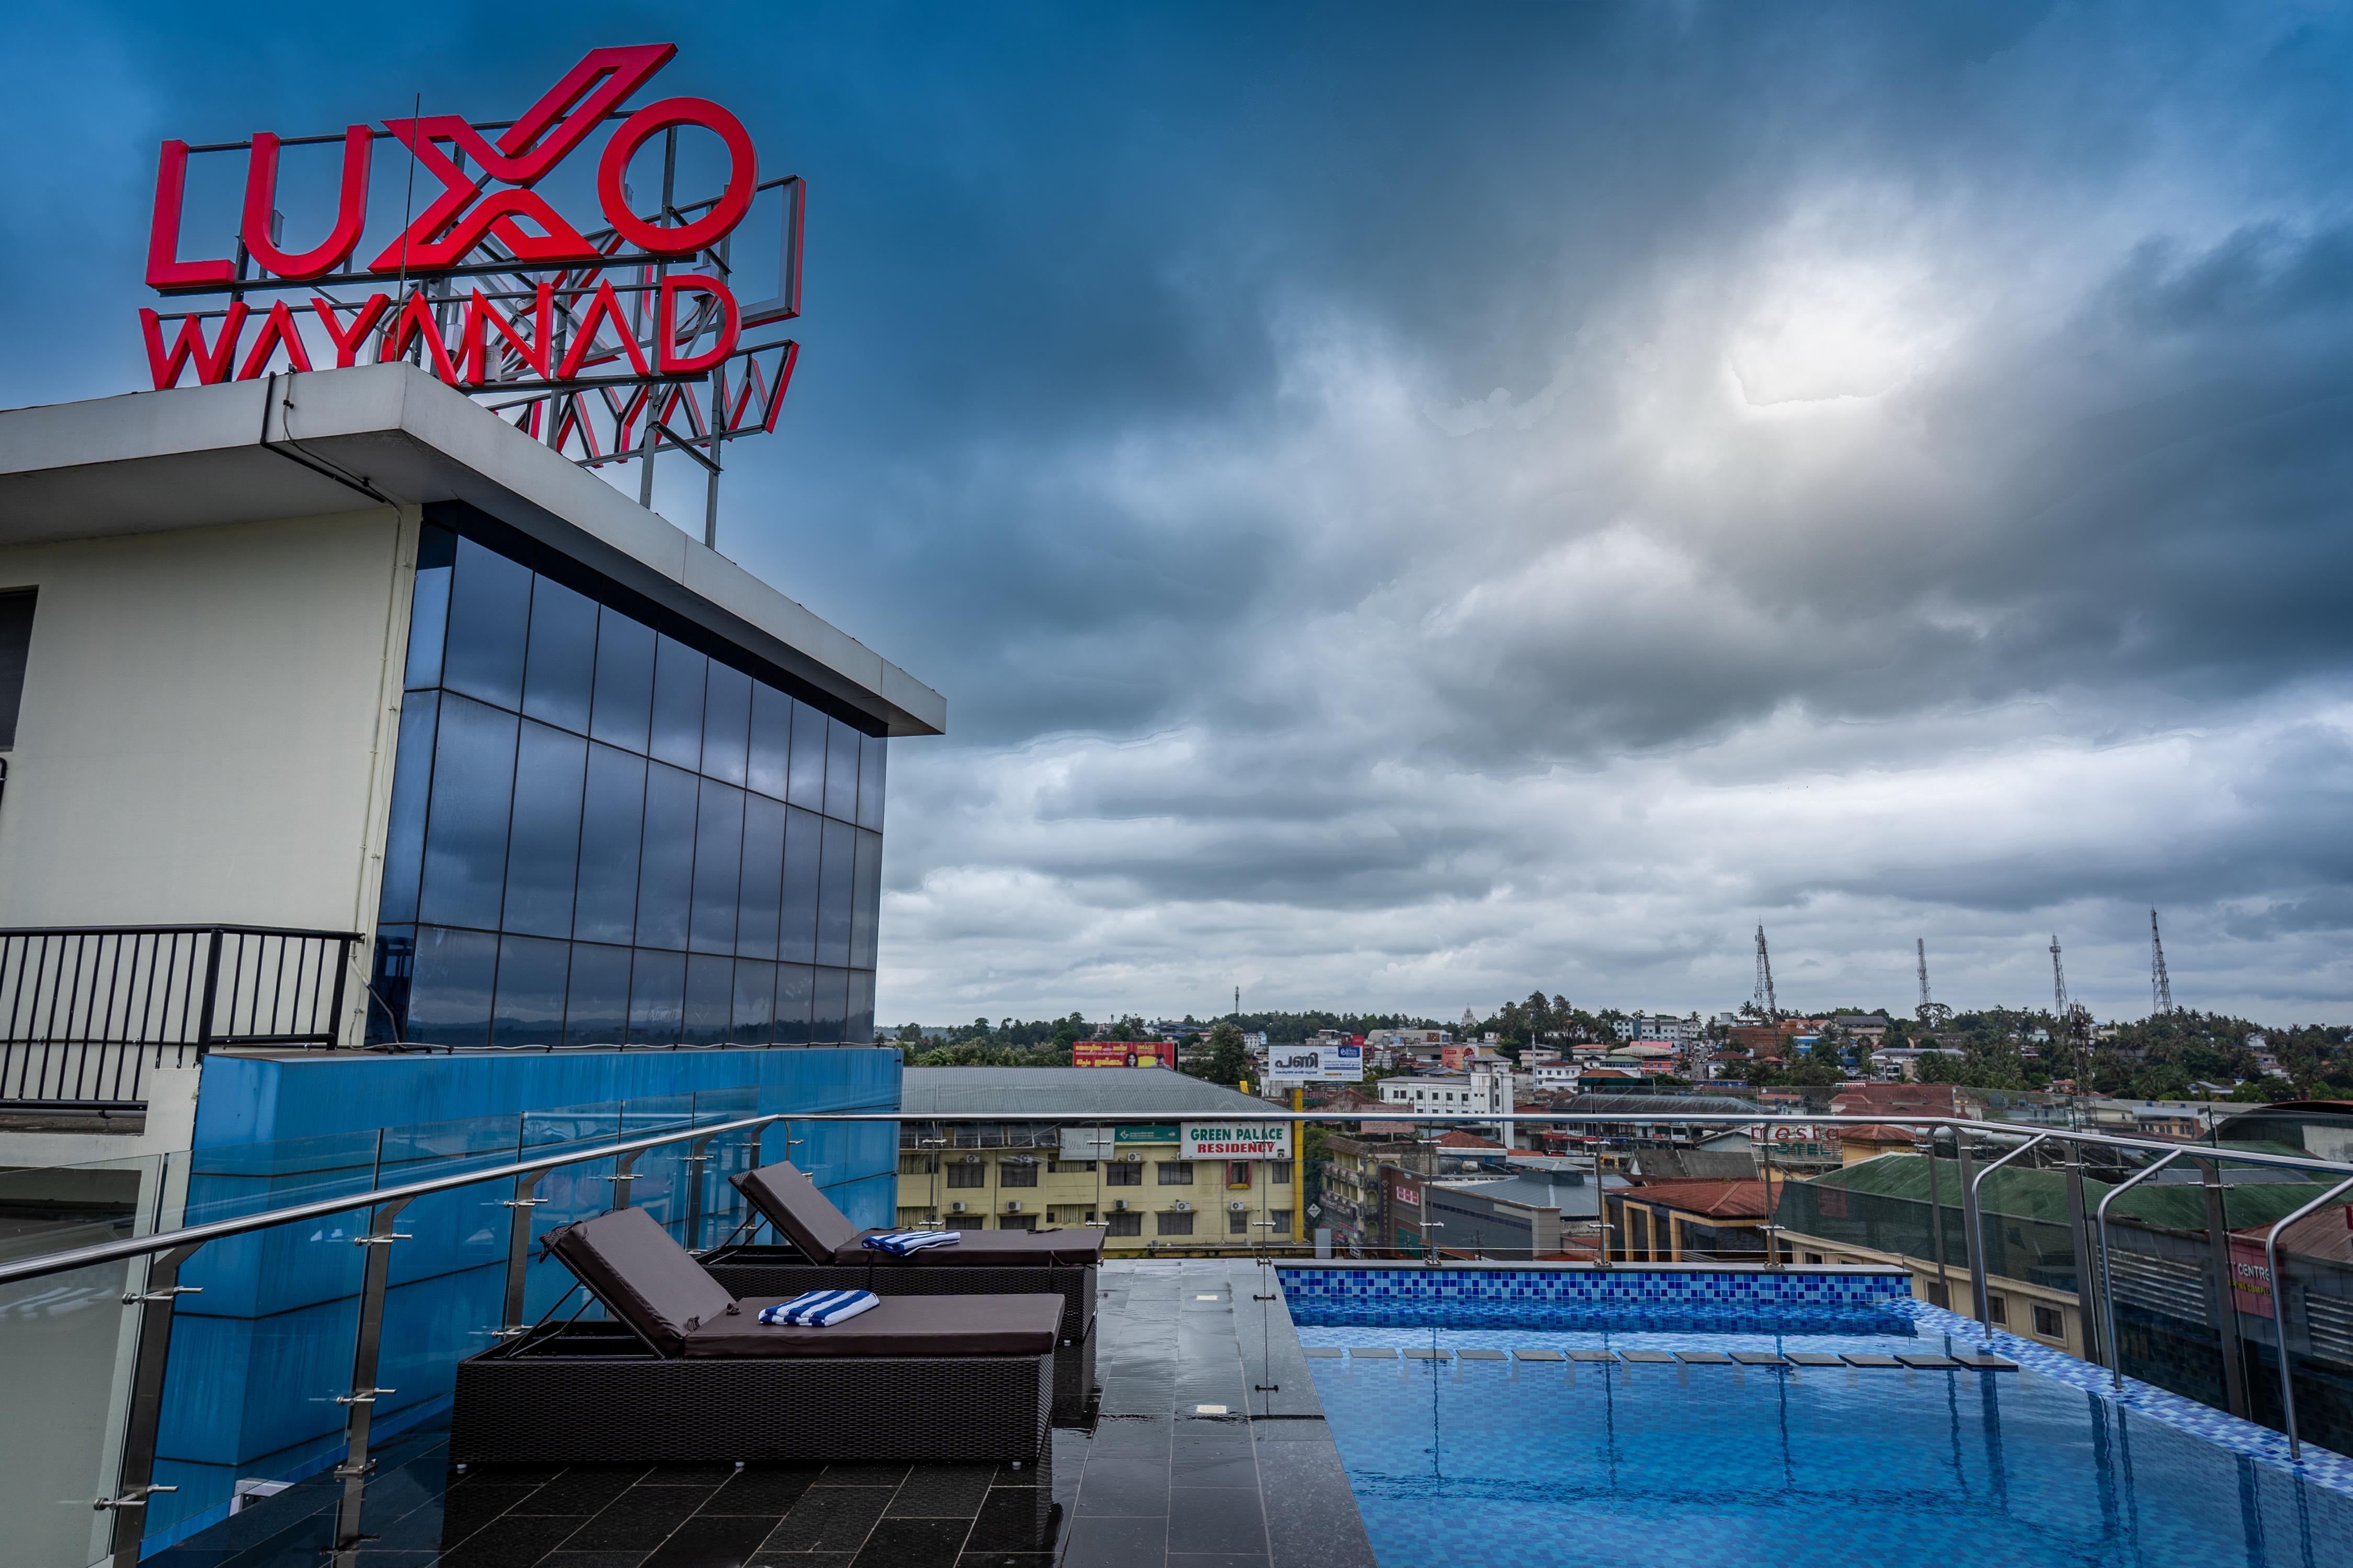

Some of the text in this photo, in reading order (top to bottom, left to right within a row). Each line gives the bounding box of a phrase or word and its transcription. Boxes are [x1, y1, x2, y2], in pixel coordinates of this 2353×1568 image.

[144, 43, 759, 290] LUXO
[138, 274, 743, 391] WAYANAD
[1275, 1052, 1319, 1068] പണി
[1191, 1128, 1283, 1140] GREEN PALACE
[1197, 1143, 1275, 1153] RESIDENCY
[2238, 1263, 2270, 1280] CENTRE
[2248, 1284, 2270, 1297] COMPLE
